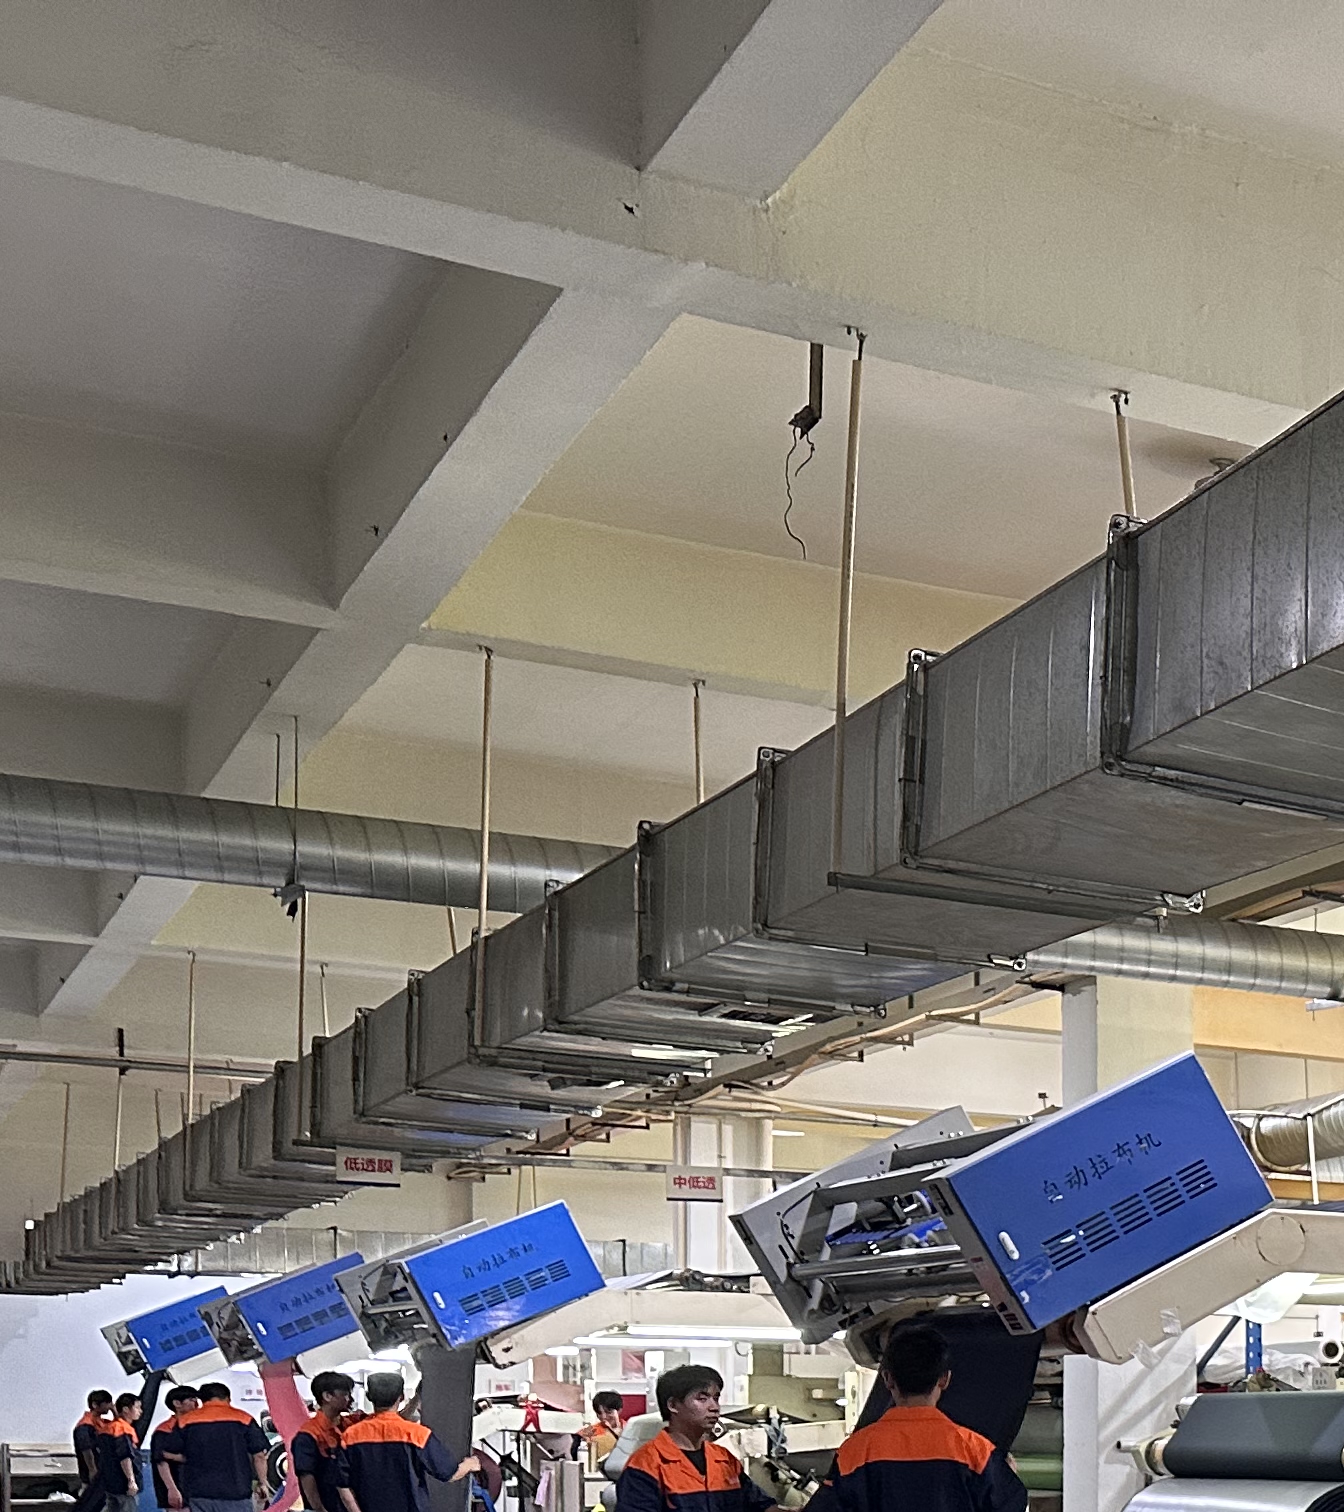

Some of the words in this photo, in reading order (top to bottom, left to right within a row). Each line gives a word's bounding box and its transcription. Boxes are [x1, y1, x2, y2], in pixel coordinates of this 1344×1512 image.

[343, 1156, 394, 1174] 低透膜
[1043, 1132, 1163, 1204] 自动拉布机
[673, 1175, 717, 1191] 中低透
